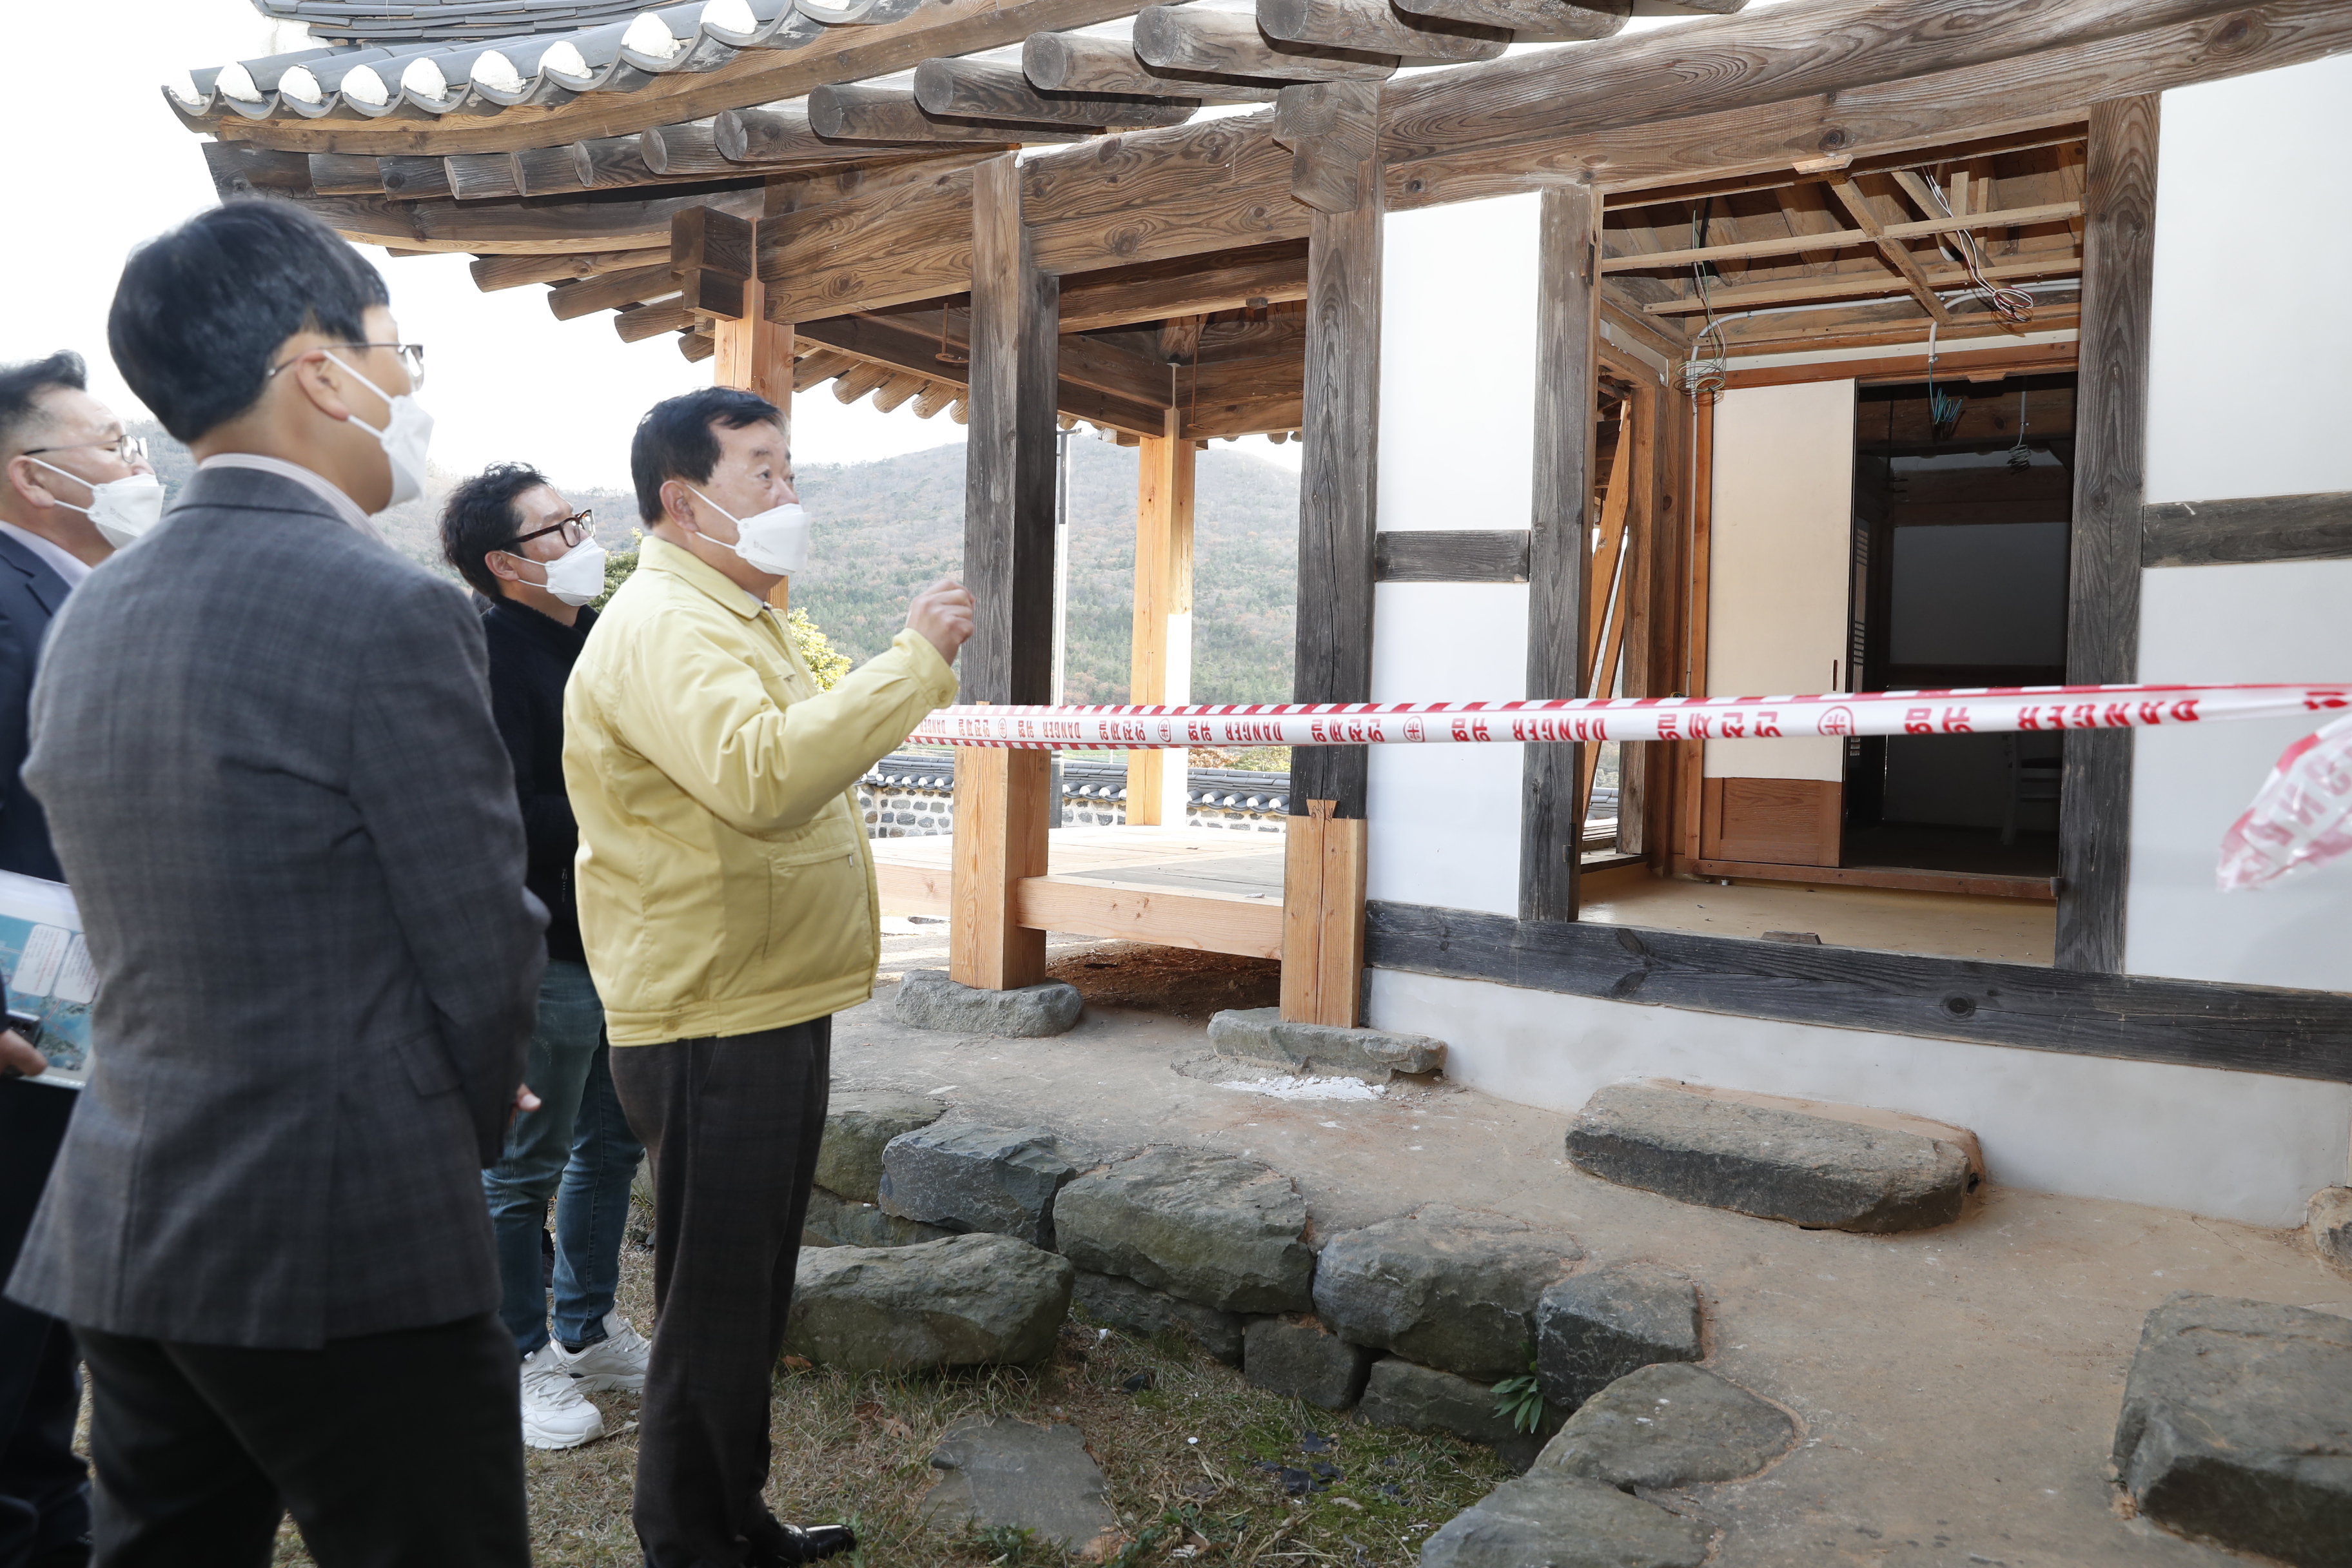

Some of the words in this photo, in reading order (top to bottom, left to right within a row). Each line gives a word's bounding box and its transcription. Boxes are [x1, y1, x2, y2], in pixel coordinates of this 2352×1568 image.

[2017, 700, 2200, 730] DANGER
[919, 719, 946, 734] DANGER
[959, 719, 990, 737] 안전제일
[1018, 720, 1035, 738] 위험
[1043, 721, 1081, 739] DANGER
[1099, 720, 1146, 741] 안전제일
[1188, 720, 1212, 741] 위험
[1225, 721, 1284, 741] DANGER
[1311, 719, 1385, 742] 안전제일
[1451, 718, 1491, 741] 위험
[1513, 718, 1608, 741] DANGER
